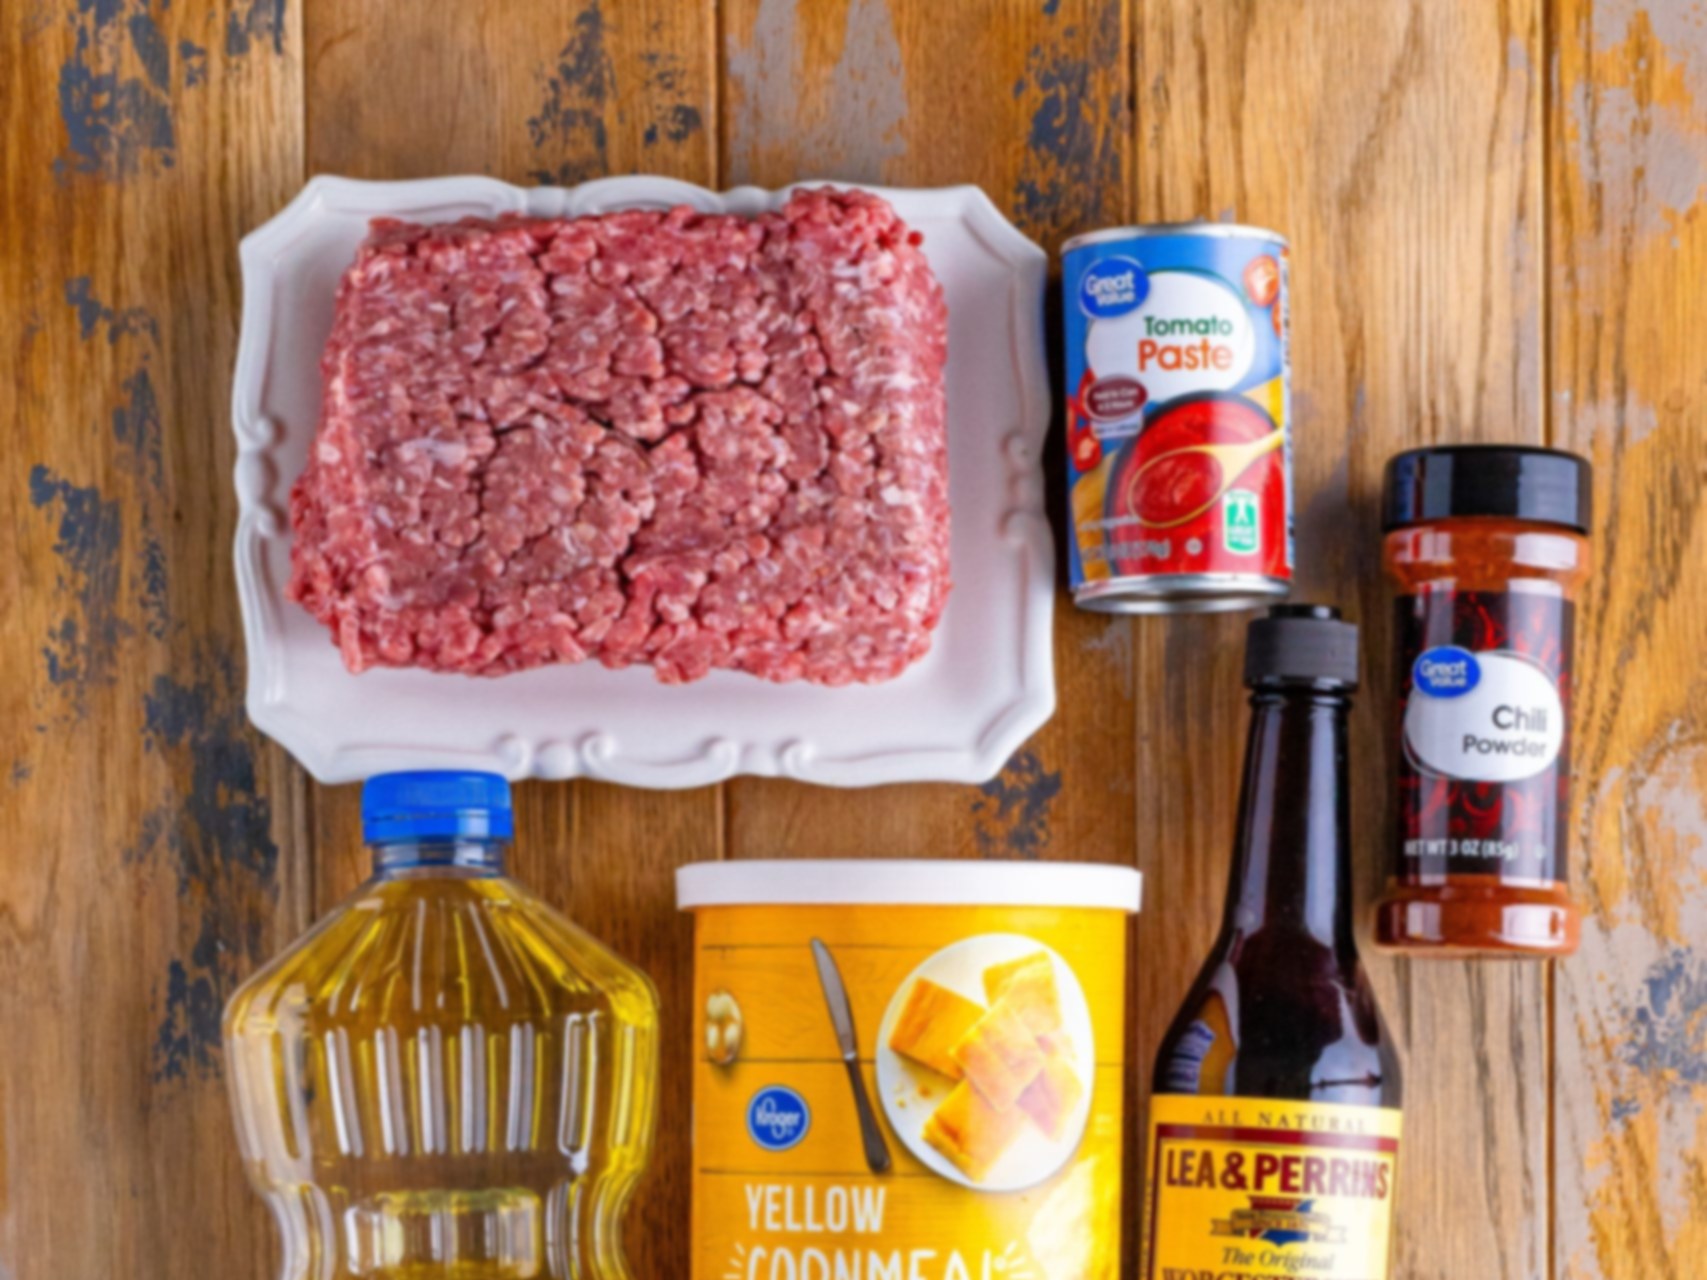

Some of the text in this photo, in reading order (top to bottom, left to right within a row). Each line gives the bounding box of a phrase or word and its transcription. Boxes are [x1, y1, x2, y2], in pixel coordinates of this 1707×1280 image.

[1085, 271, 1135, 297] Great
[1096, 289, 1136, 308] Value
[1143, 315, 1233, 336] Tomato
[1137, 339, 1233, 372] Paste
[1420, 659, 1468, 679] Great
[1429, 674, 1468, 689] Value
[1491, 705, 1547, 733] Chili
[1462, 734, 1547, 757] Powder
[1461, 839, 1480, 856] OZ
[755, 1097, 801, 1139] Kroger
[1202, 1109, 1367, 1134] ALL NATURAL
[744, 1184, 885, 1232] YELLOW
[1221, 1247, 1335, 1274] The Original
